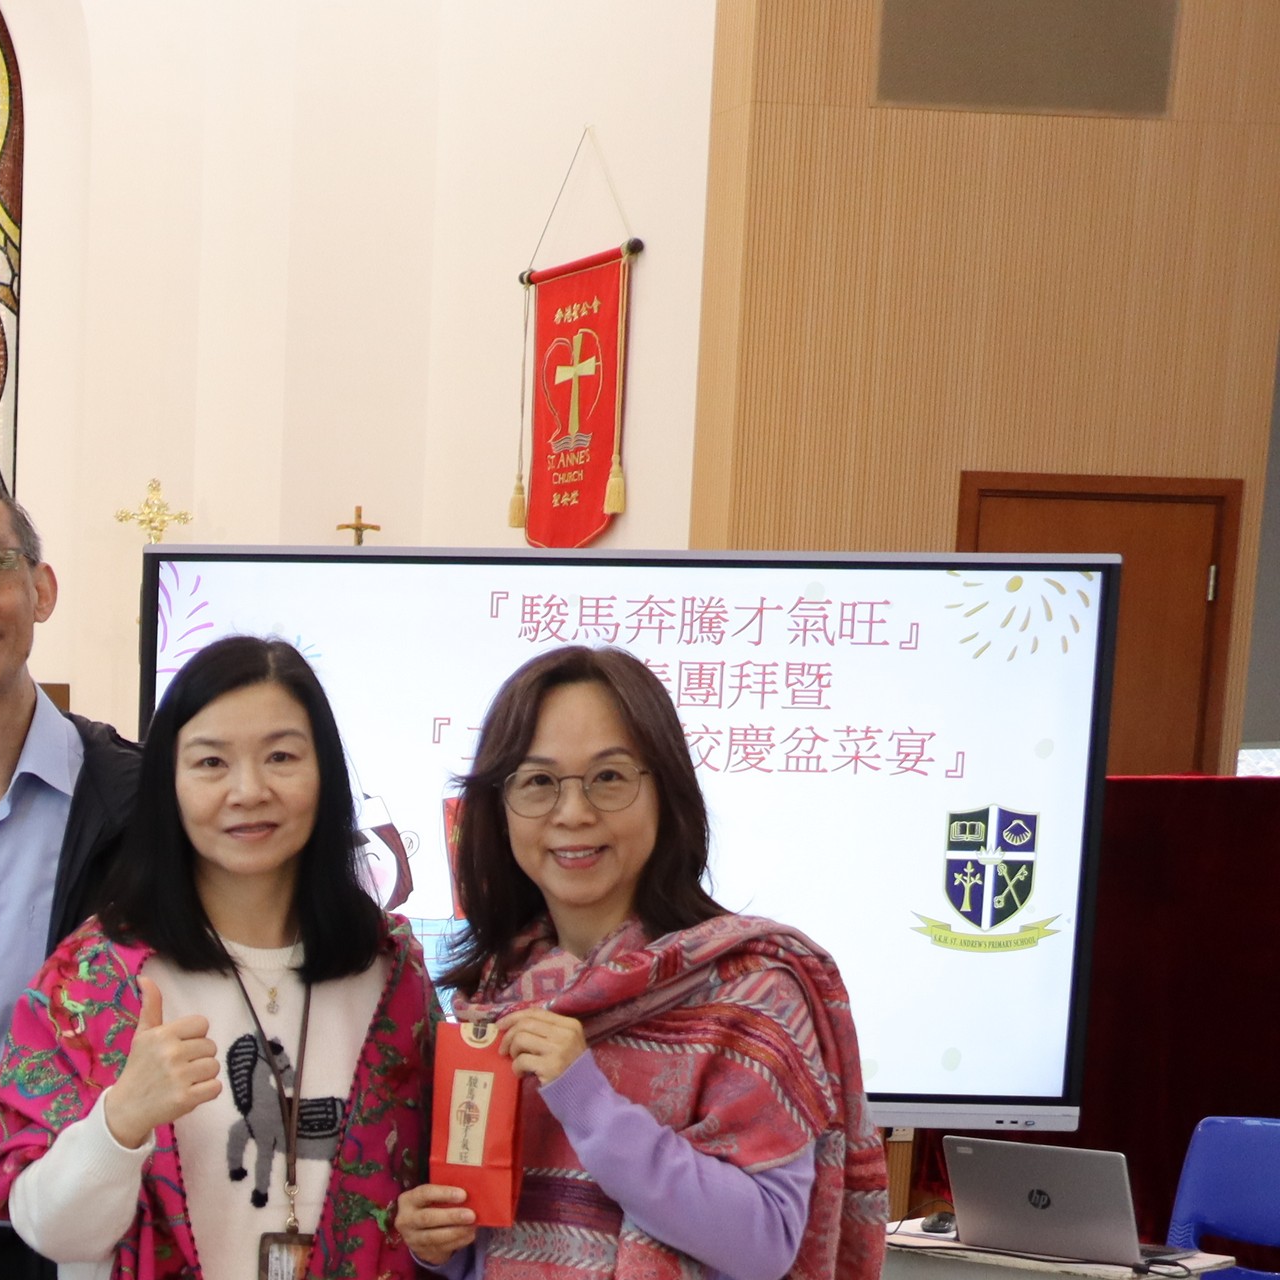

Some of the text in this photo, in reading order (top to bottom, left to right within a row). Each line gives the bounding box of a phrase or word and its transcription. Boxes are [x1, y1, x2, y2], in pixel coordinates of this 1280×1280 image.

[489, 591, 920, 651] 『駿馬奔騰才氣旺』
[987, 938, 1013, 949] PRIMARY
[1013, 935, 1036, 948] SCHOOL
[1030, 1189, 1050, 1209] hp
